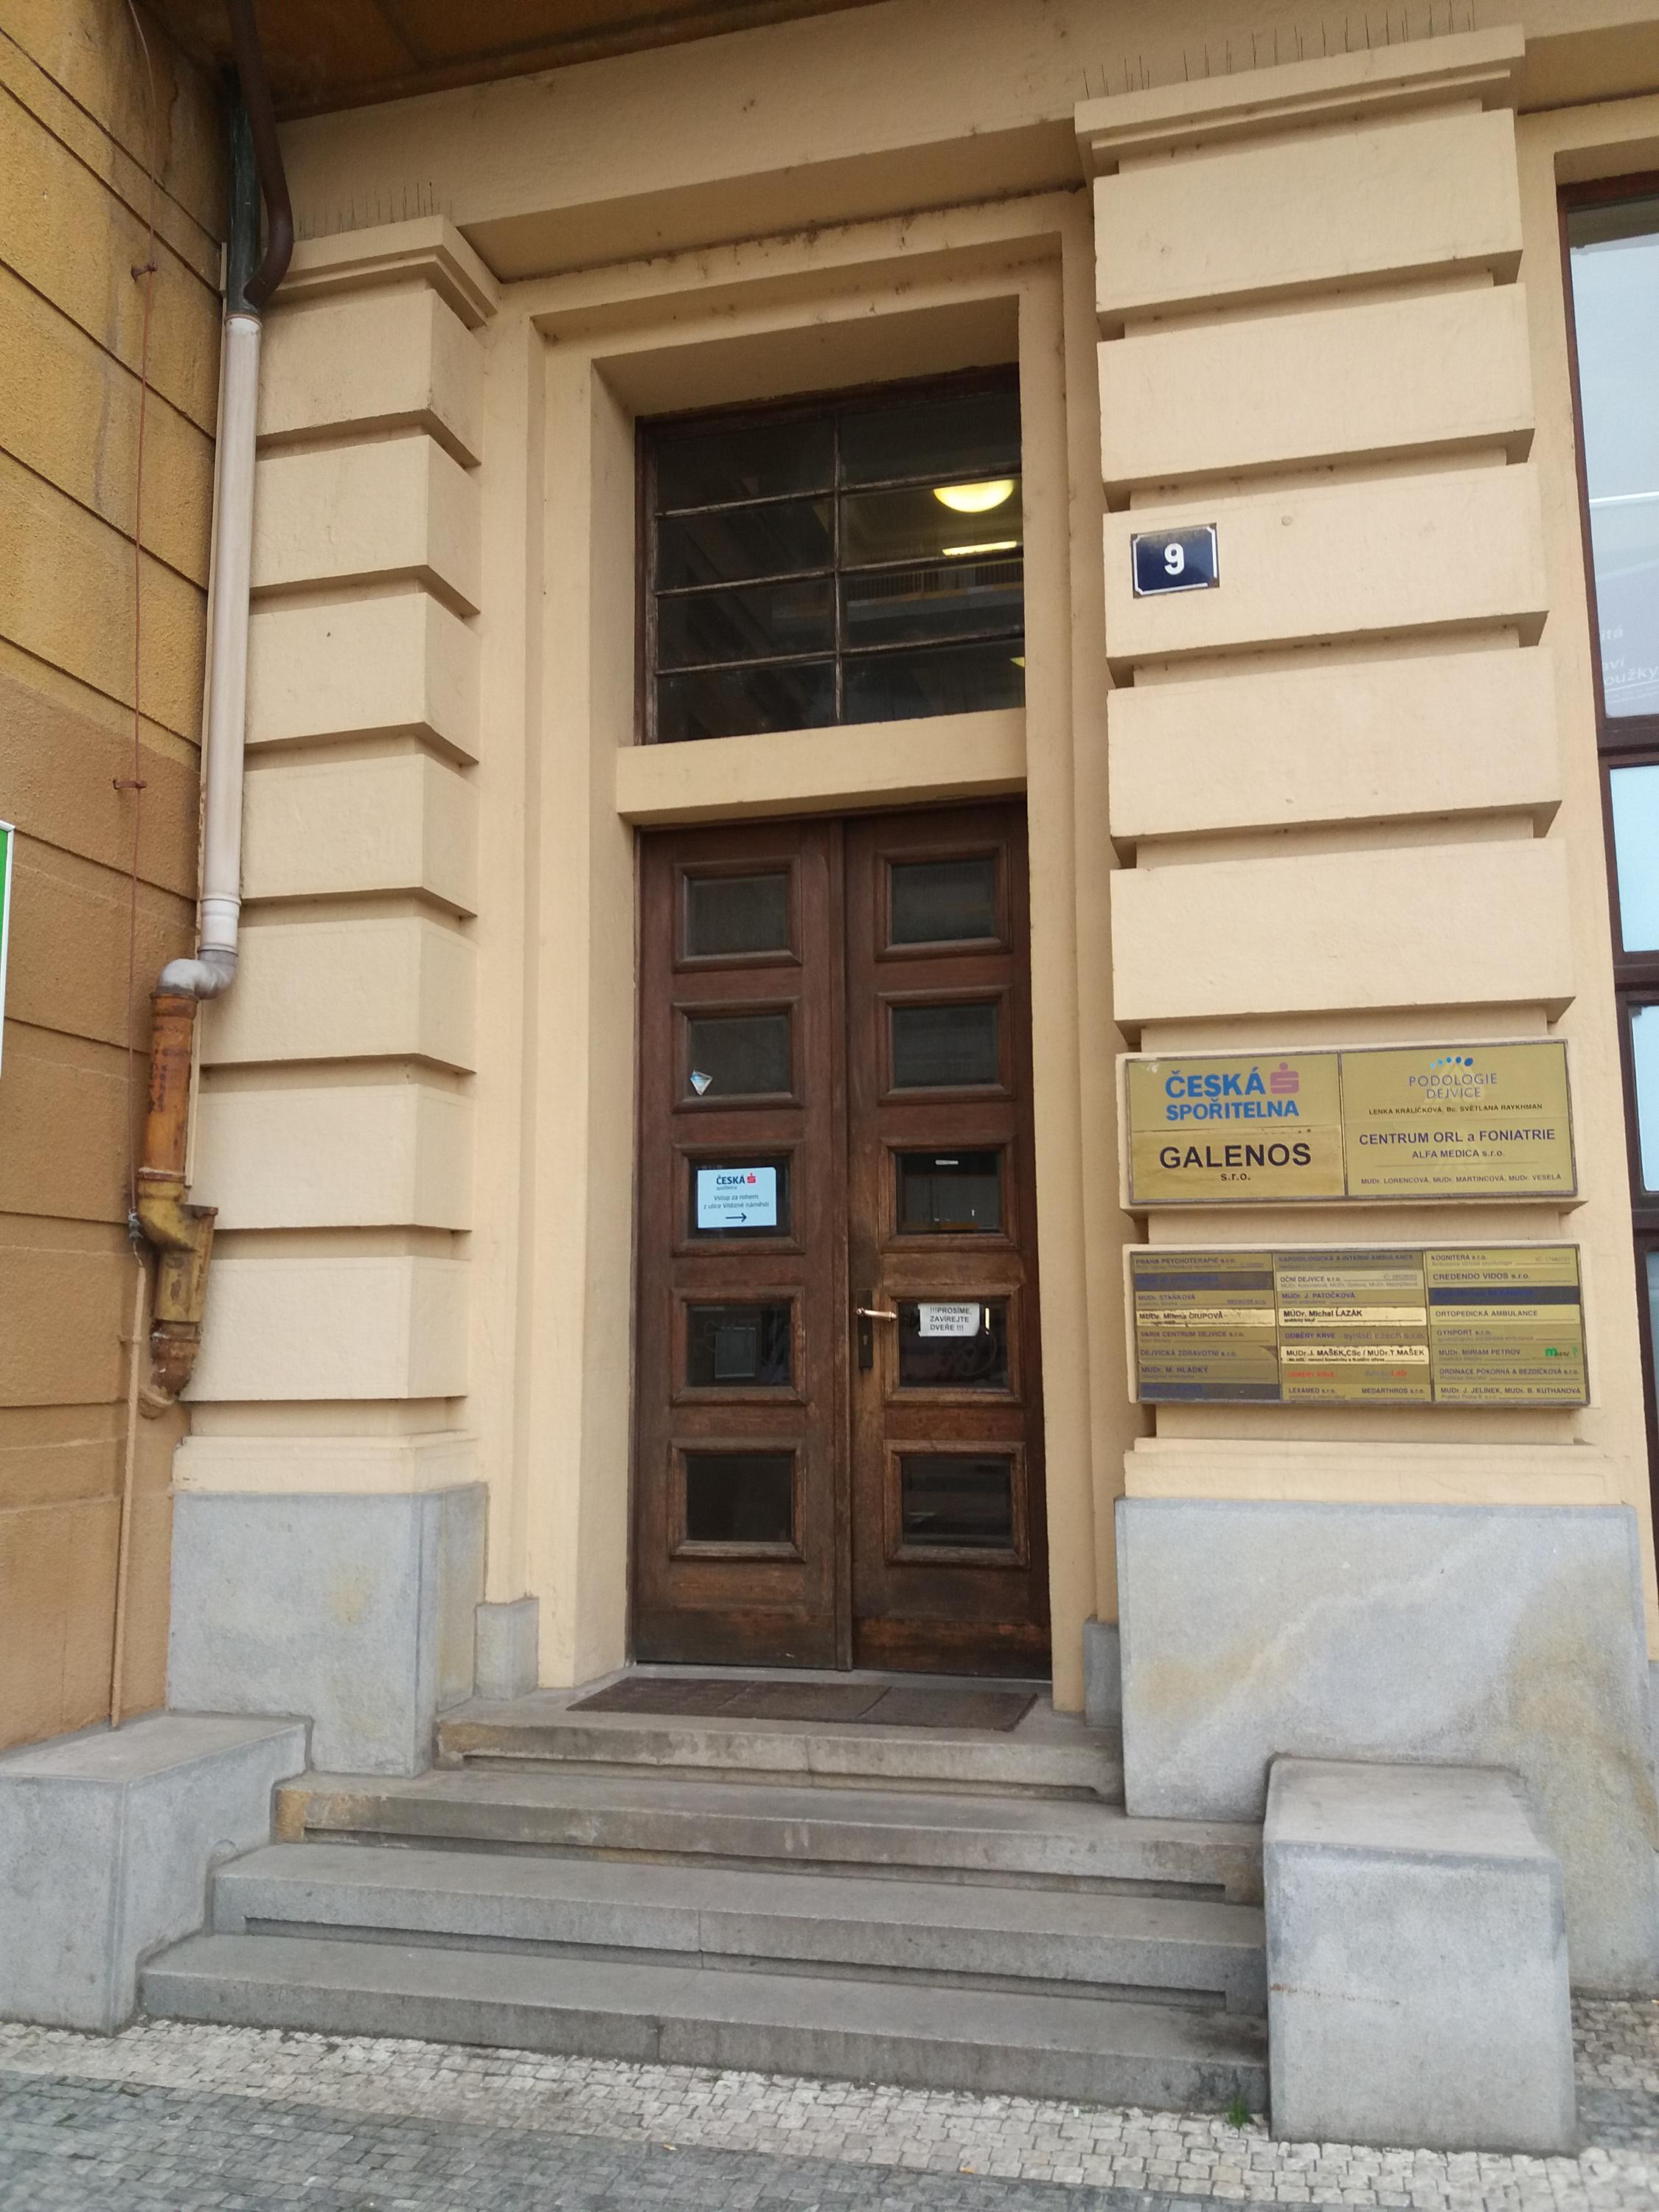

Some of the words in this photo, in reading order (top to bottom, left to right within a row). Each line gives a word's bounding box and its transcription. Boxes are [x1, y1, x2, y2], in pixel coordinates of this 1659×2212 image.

[1164, 543, 1185, 575] 9
[1165, 1066, 1266, 1098] ČESKÁ
[1409, 1073, 1498, 1086] PODOLOGIE
[1427, 1088, 1481, 1099] DEJVICE
[1166, 1099, 1299, 1121] SPOŘITELNA
[1359, 1132, 1429, 1145] CENTRUM
[1433, 1131, 1463, 1143] ORL
[1467, 1133, 1475, 1142] a
[1479, 1129, 1556, 1141] FONIATRIE
[1159, 1143, 1312, 1169] GALENOS
[1412, 1150, 1438, 1158] ALFA
[1440, 1150, 1480, 1158] MEDICA
[1482, 1150, 1506, 1158] s.r.o.
[716, 1174, 745, 1185] ČESKÁ
[1220, 1172, 1251, 1181] s.r.o.
